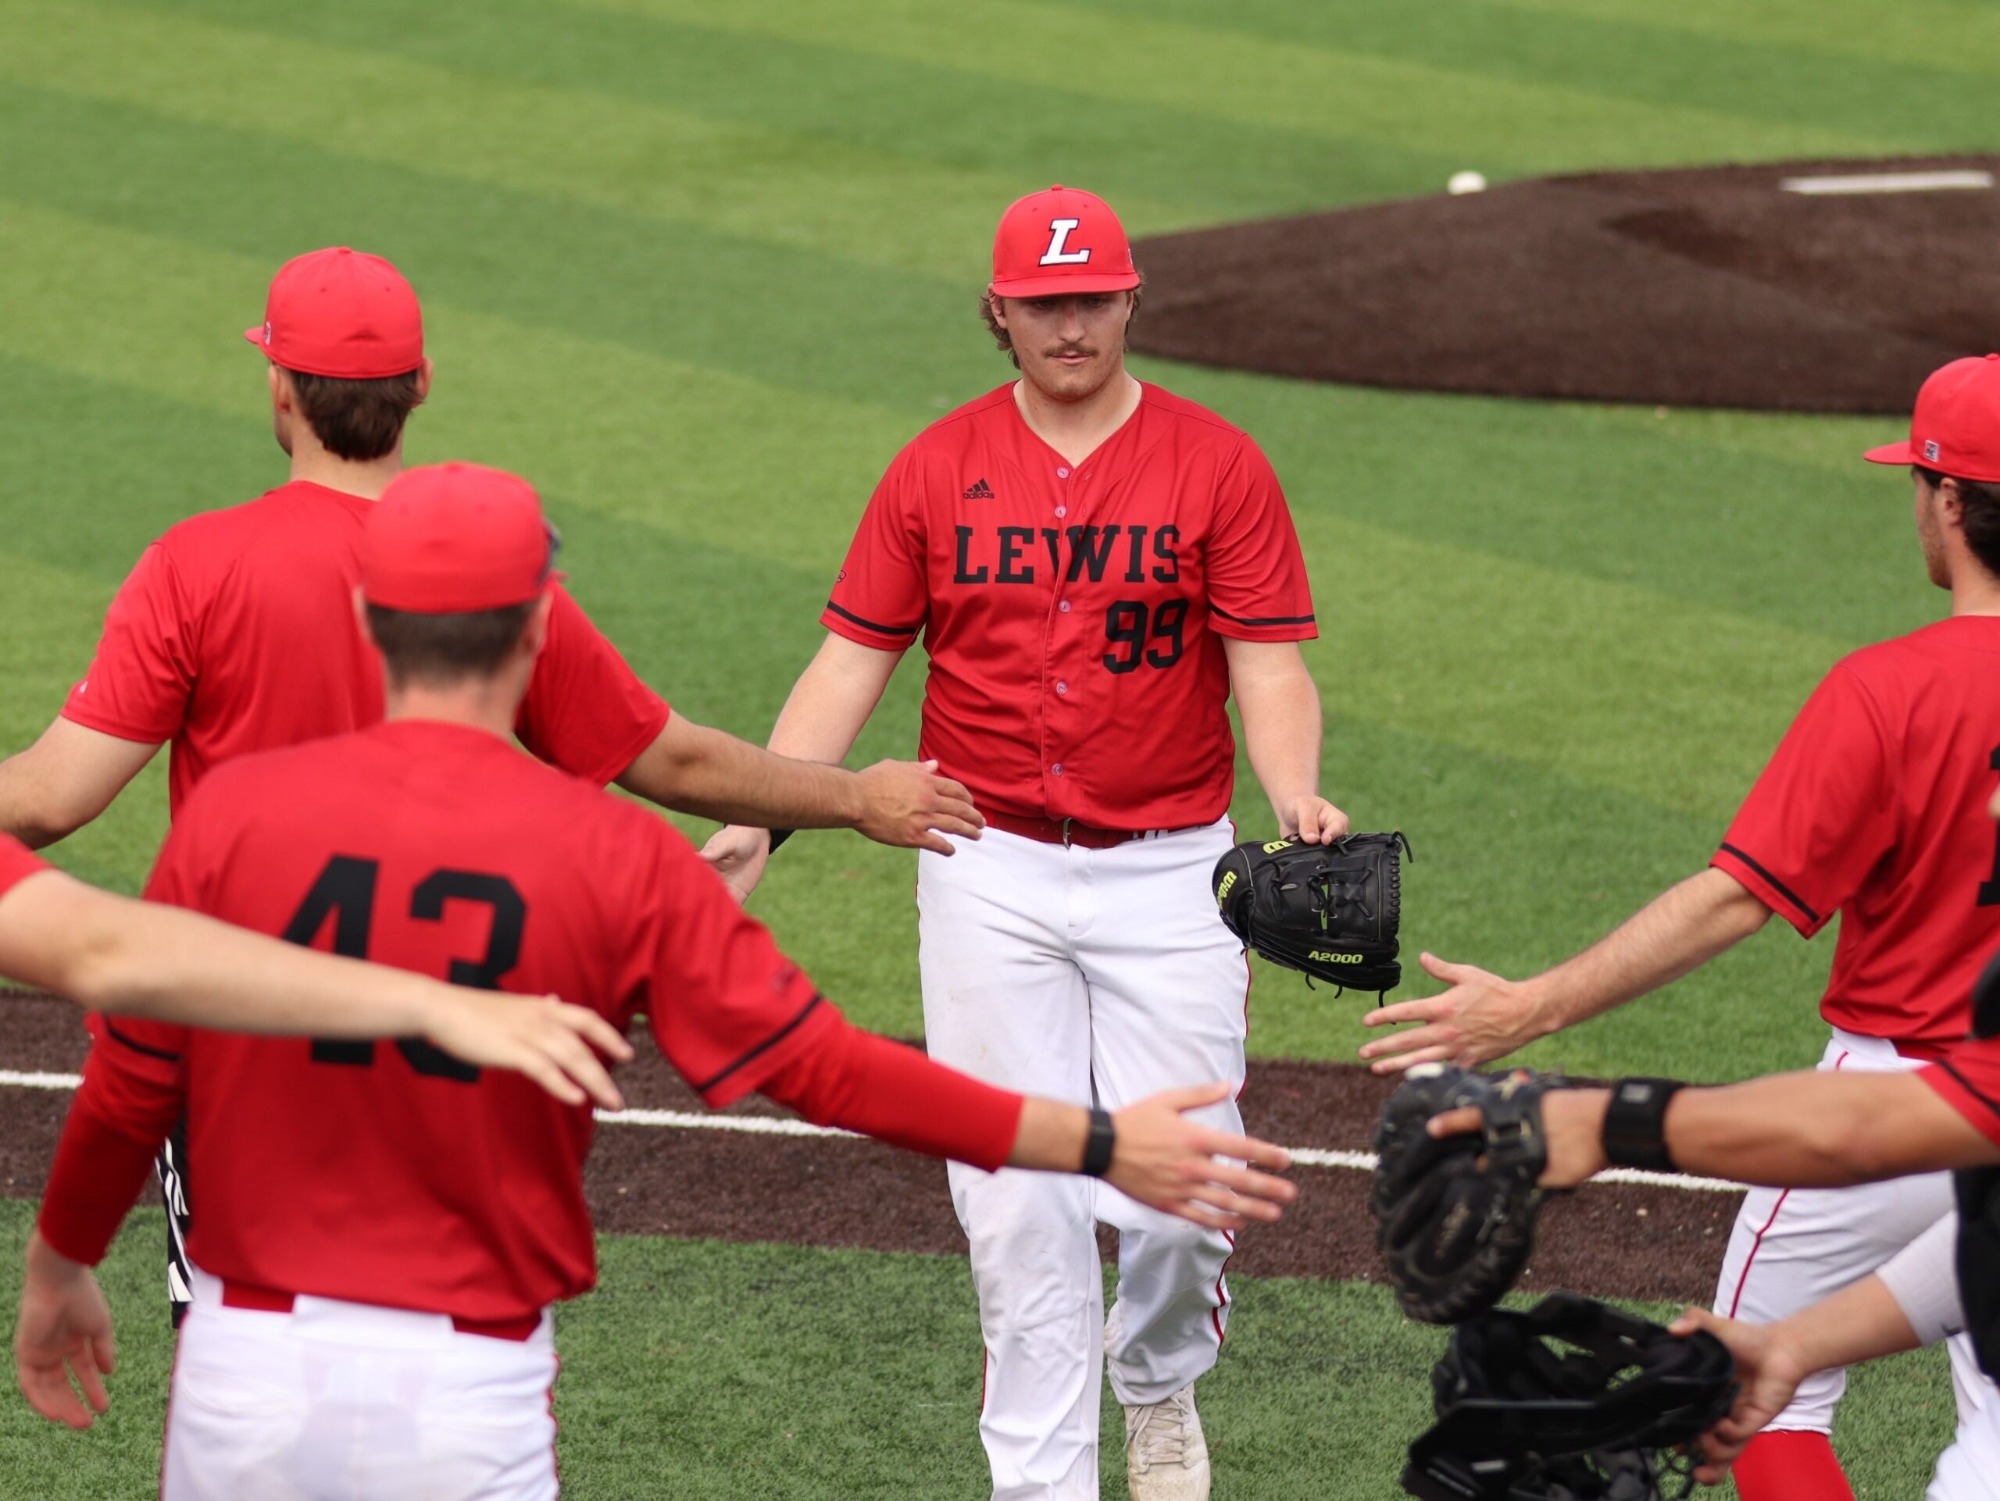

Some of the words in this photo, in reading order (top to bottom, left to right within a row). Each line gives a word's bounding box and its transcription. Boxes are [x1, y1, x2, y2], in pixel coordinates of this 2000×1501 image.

[1038, 218, 1091, 267] L
[962, 491, 995, 500] adidas
[953, 524, 1182, 584] LEWIS
[1103, 599, 1189, 675] 99
[278, 852, 528, 1084] 43
[1308, 950, 1363, 964] A2000
